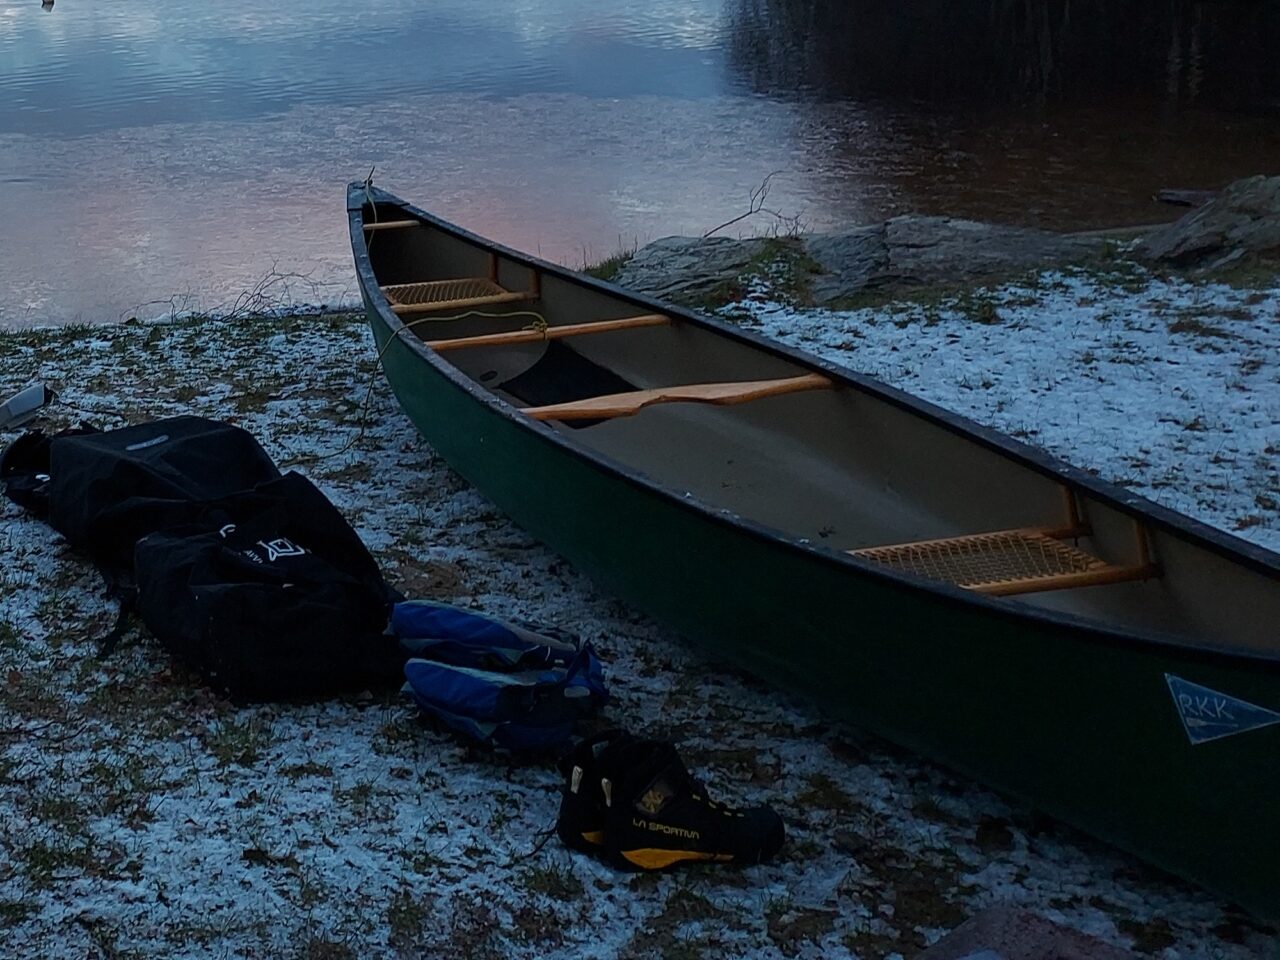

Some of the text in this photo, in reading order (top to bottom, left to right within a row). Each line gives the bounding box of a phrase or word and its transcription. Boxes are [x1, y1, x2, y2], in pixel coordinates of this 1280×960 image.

[1179, 693, 1234, 720] RKK
[632, 817, 700, 839] LA SPORTIVA
